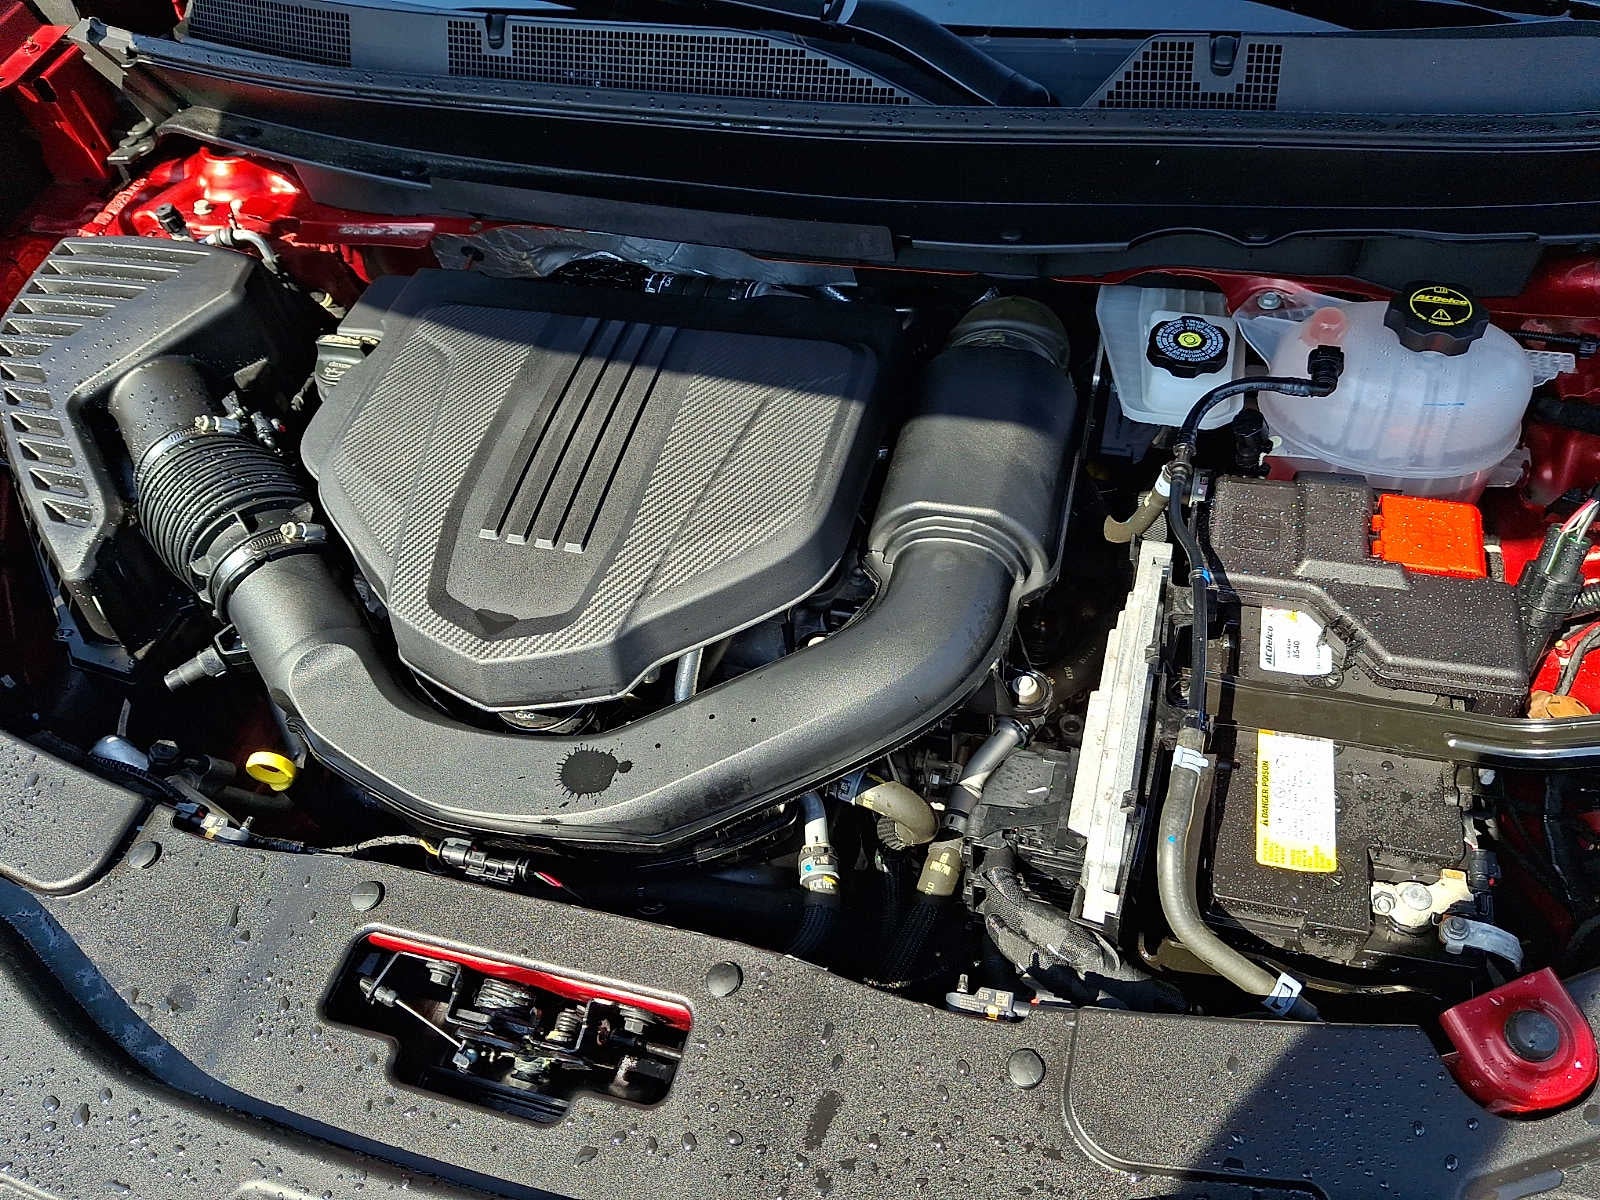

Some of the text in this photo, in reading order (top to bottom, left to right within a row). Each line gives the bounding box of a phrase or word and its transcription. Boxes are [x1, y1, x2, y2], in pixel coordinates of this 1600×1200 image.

[1414, 294, 1469, 306] ACDelco
[1265, 626, 1274, 665] ACDelco
[1261, 760, 1269, 819] DANGER POISON
